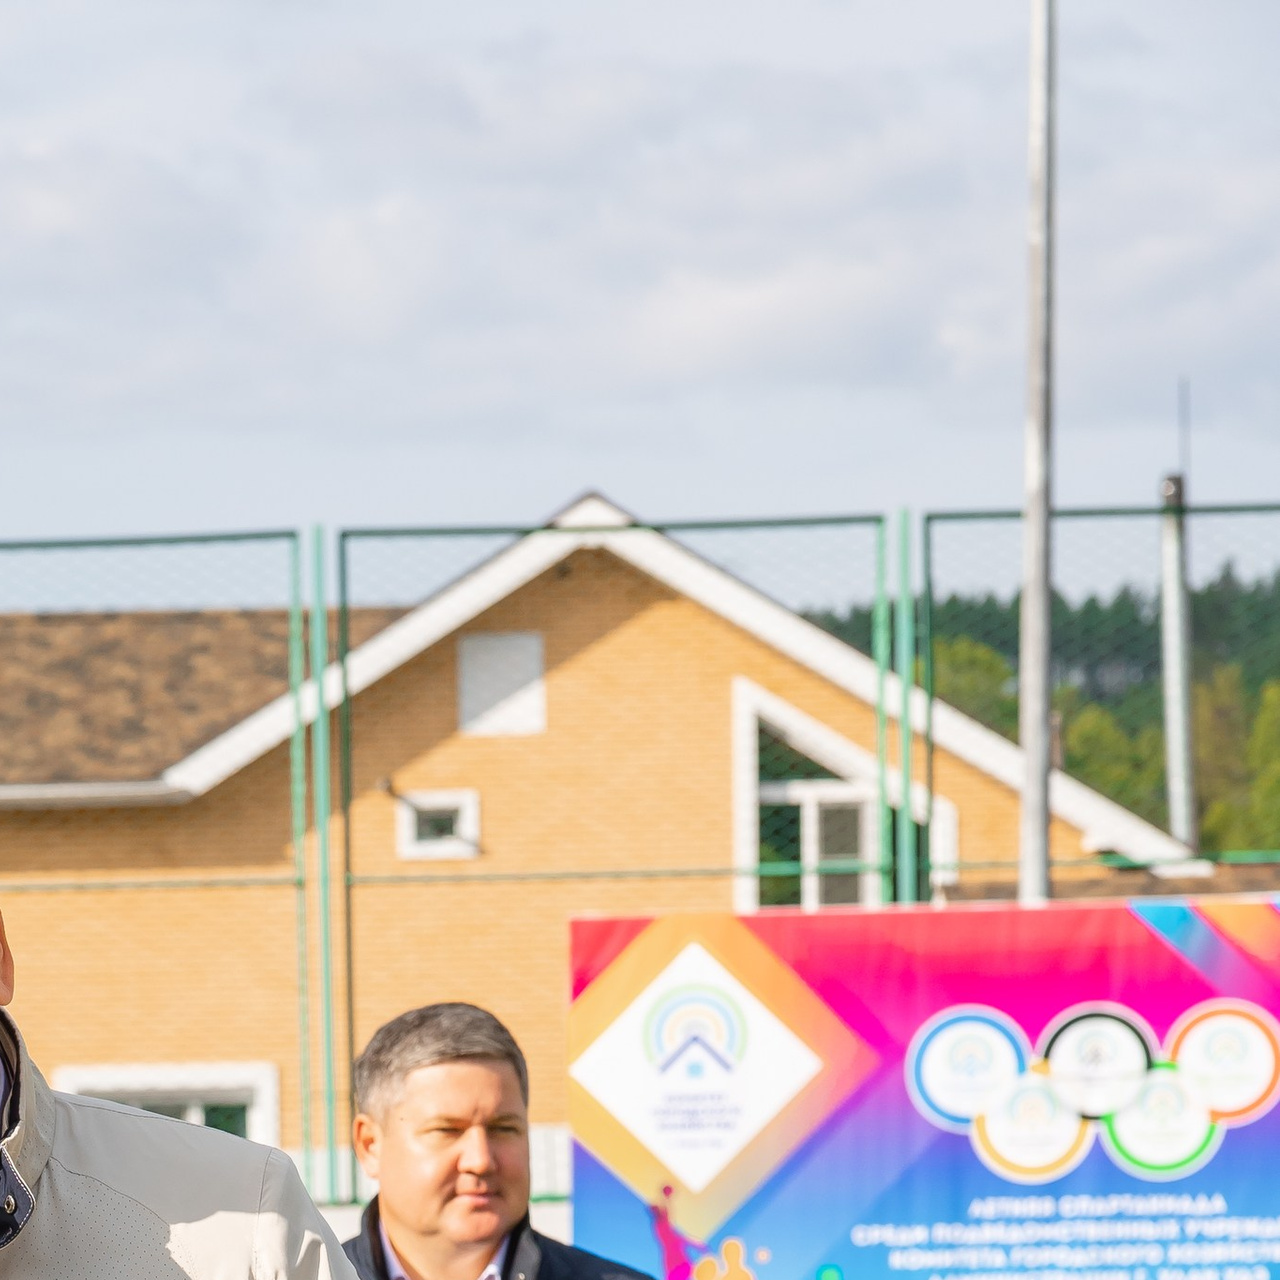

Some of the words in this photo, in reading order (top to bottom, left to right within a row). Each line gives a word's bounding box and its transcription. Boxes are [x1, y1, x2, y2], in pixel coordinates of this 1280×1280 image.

[1059, 1193, 1227, 1218] СПАРТАКИАДА
[851, 1224, 928, 1247] СРЕДИ
[888, 1247, 1006, 1270] КОМИТЕТА
[1010, 1243, 1164, 1268] ГОРОДСКОГО
